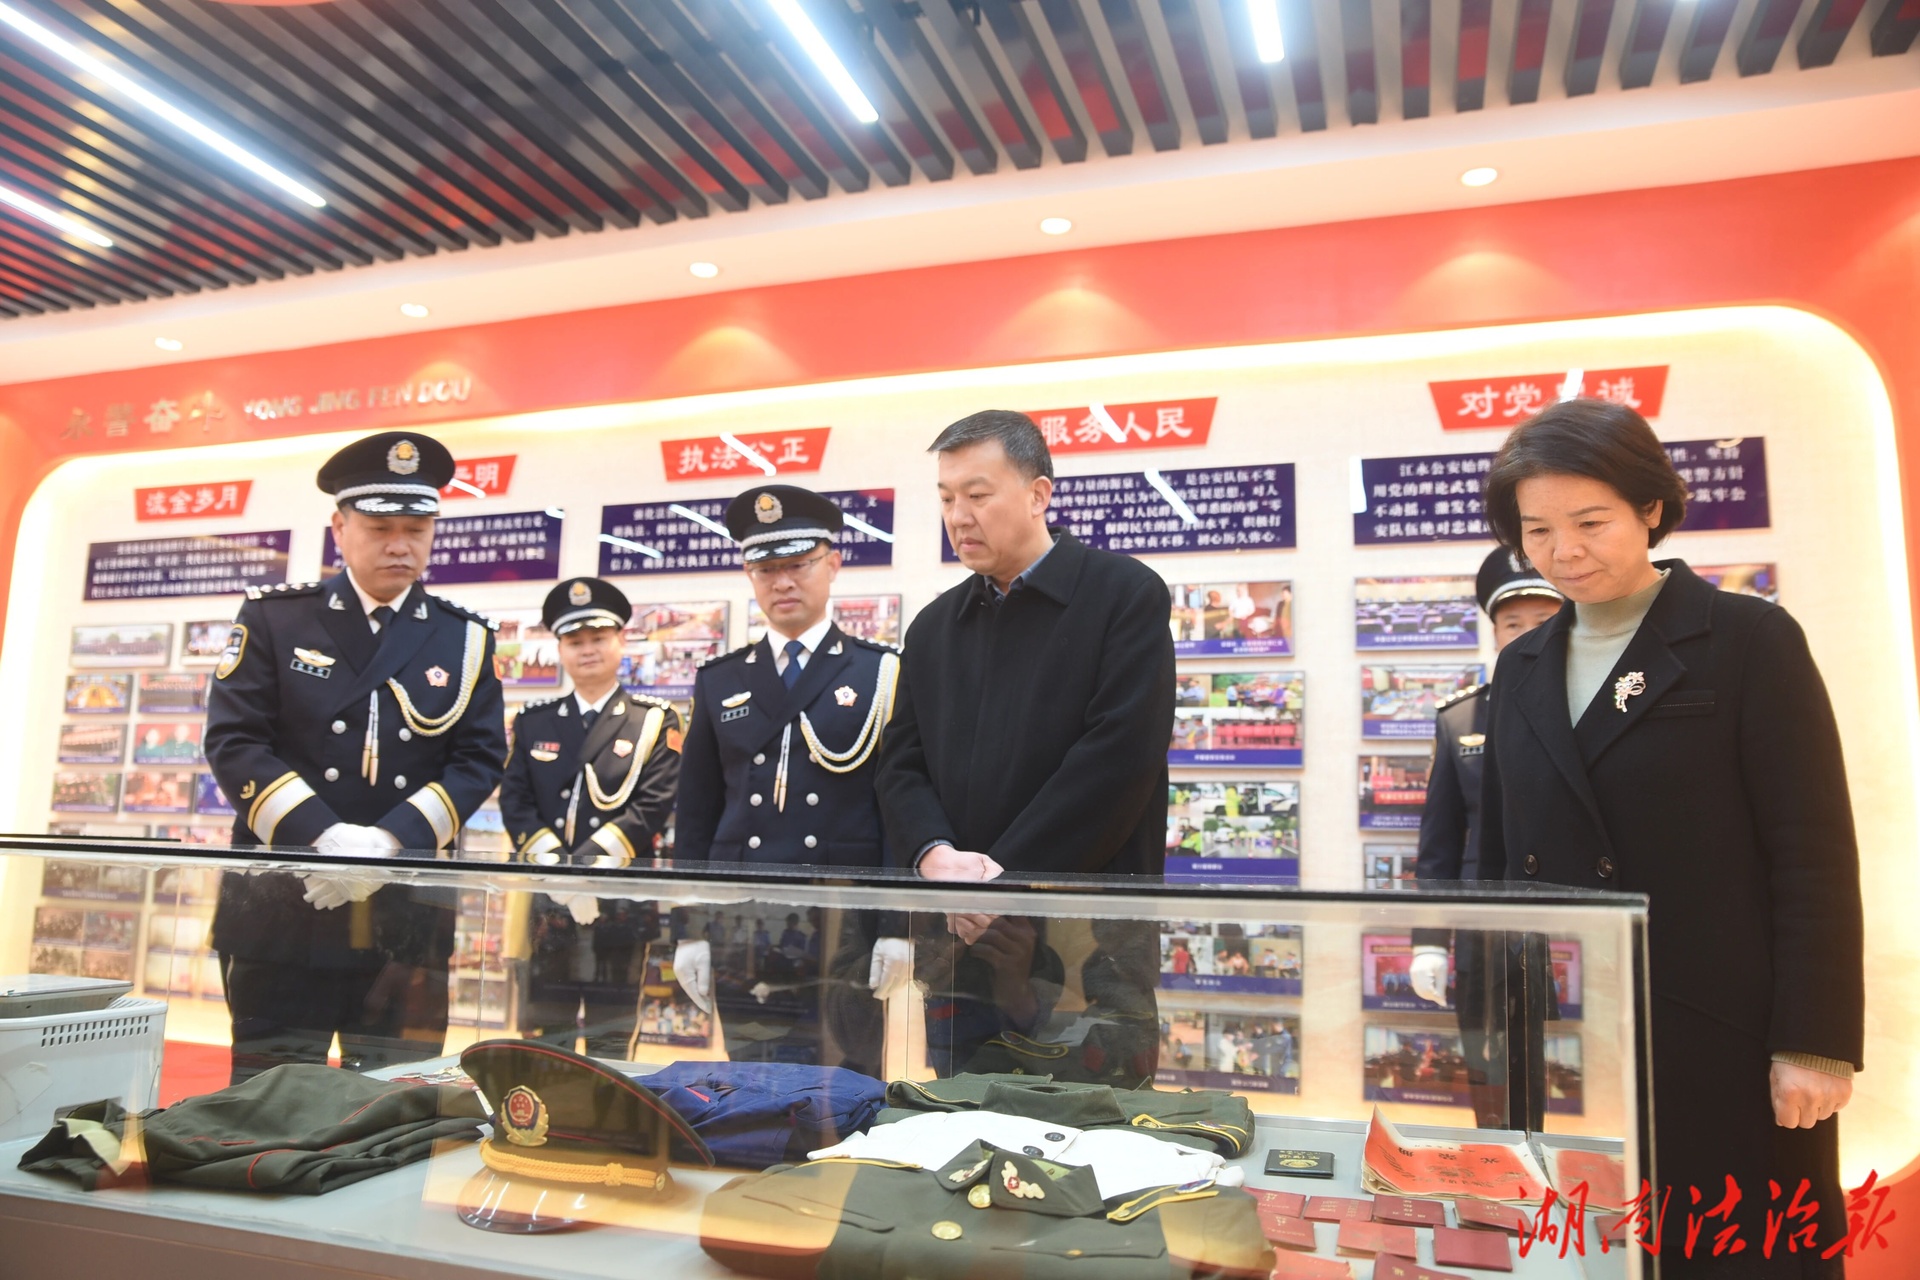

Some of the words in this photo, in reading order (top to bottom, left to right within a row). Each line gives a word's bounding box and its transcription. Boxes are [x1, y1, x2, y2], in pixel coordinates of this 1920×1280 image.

[60, 389, 225, 442] 永警奋斗
[244, 395, 302, 420] YONG
[309, 388, 361, 415] JING
[367, 383, 412, 409] FEN
[417, 376, 472, 404] DOU
[1457, 376, 1642, 420] 对党诚
[1040, 407, 1193, 446] 服务人民
[146, 485, 238, 515] 流金岁月
